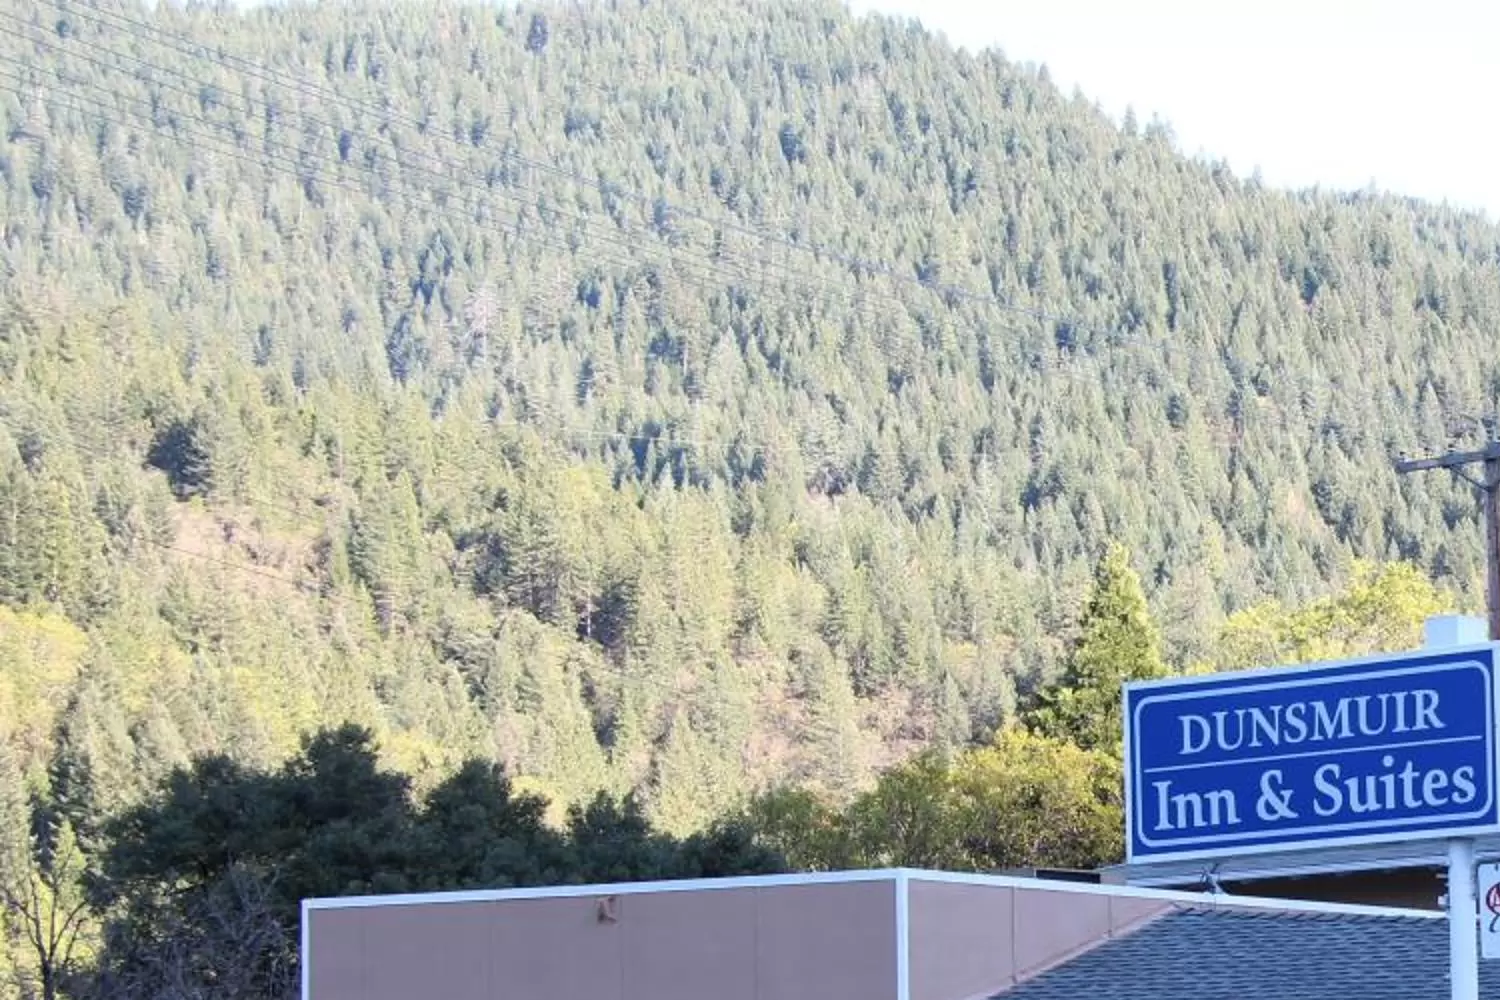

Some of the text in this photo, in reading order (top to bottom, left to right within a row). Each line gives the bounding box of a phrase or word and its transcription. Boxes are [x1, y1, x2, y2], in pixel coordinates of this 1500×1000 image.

[1179, 689, 1446, 755] DUNSMUIR
[1152, 755, 1476, 831] Inn & Suites
